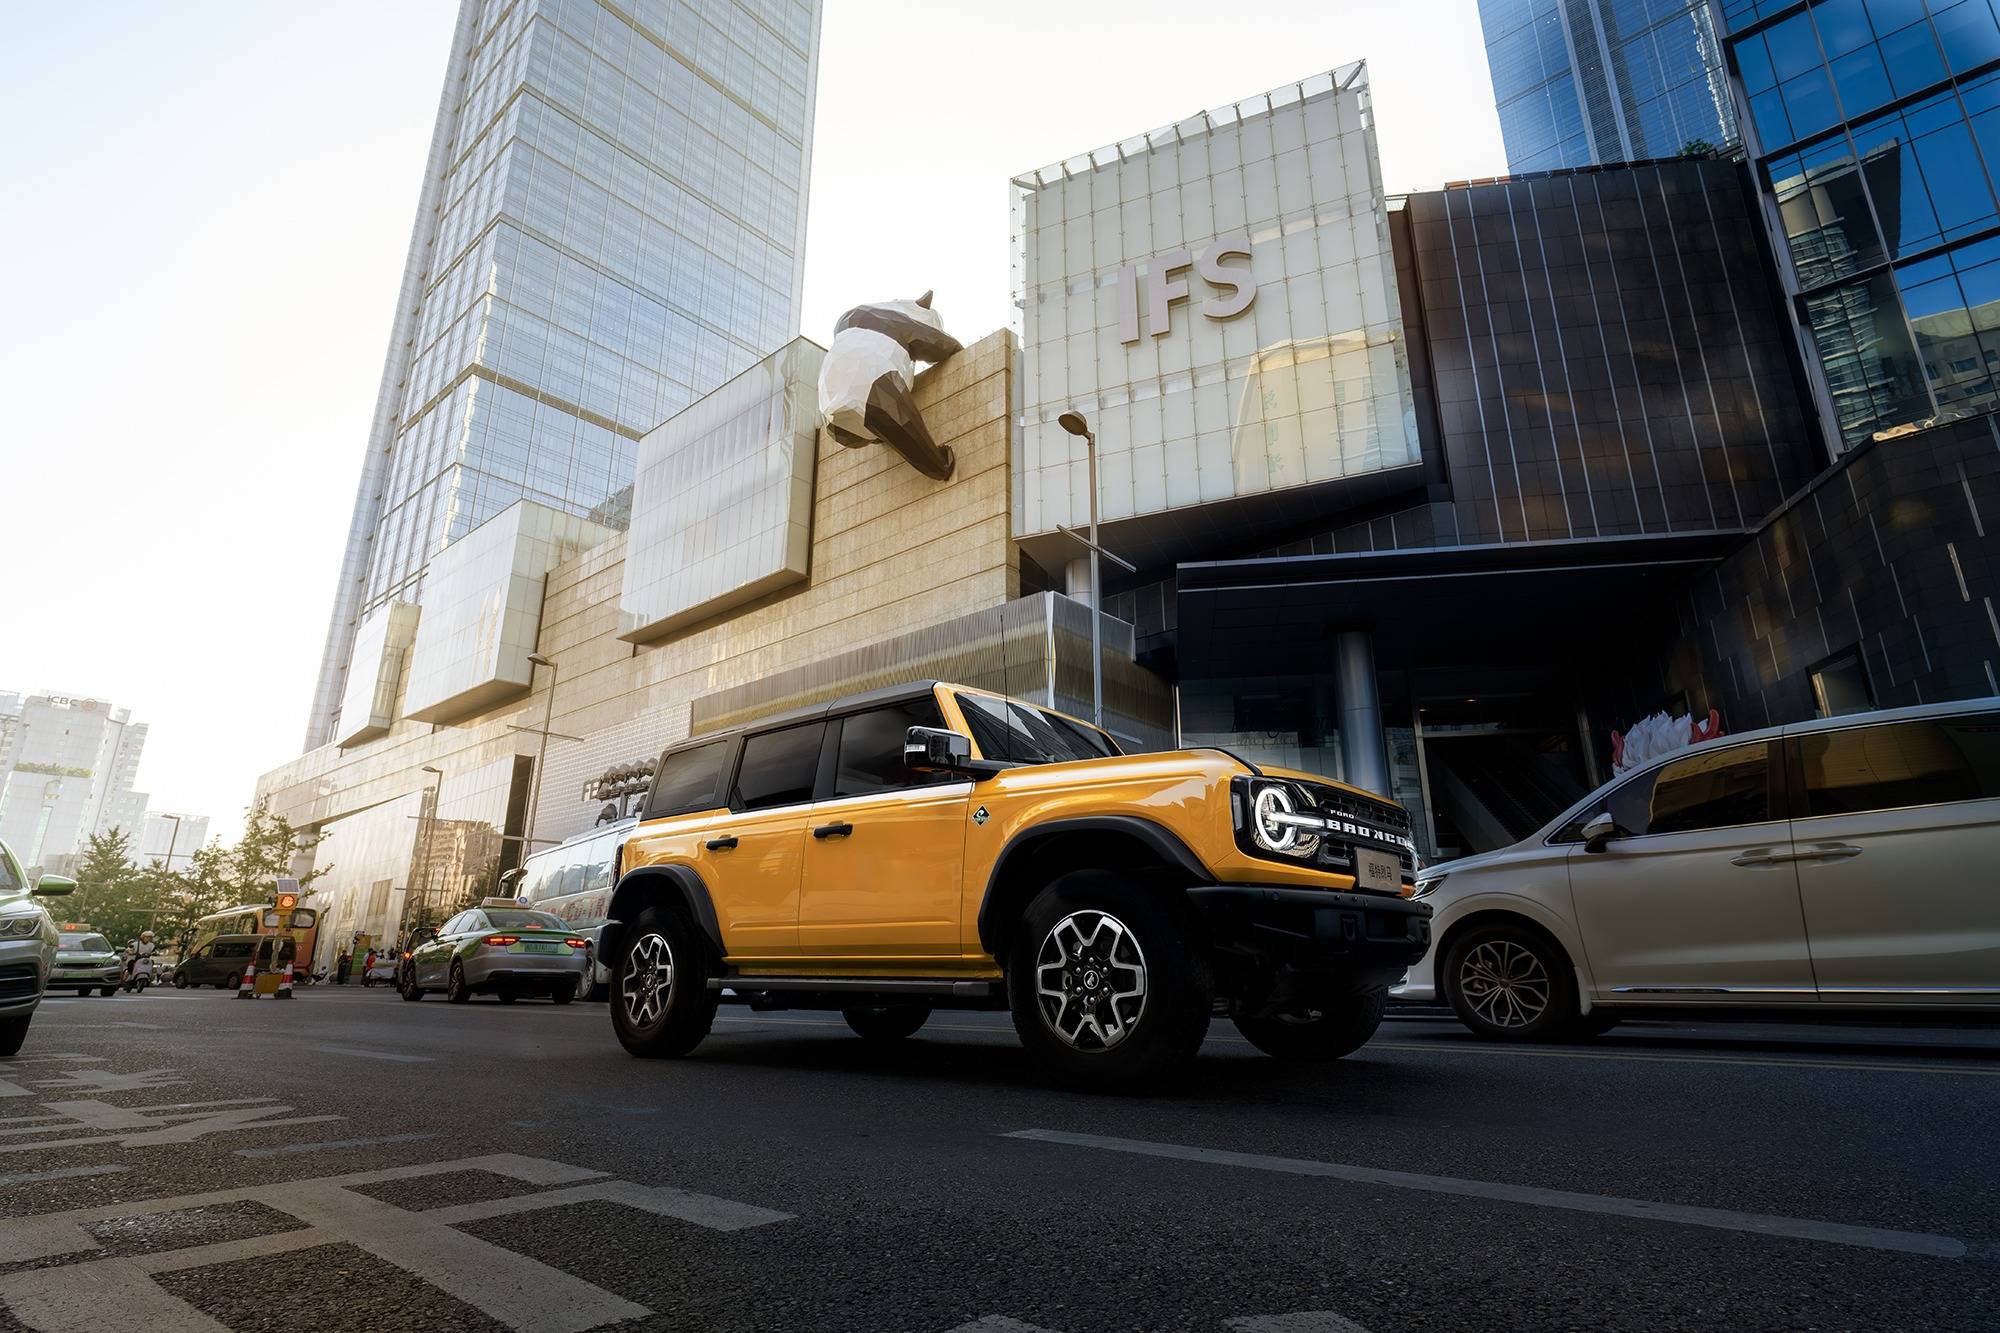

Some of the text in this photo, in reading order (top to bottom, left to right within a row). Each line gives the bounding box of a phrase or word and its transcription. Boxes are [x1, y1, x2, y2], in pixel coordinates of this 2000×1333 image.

[1118, 233, 1257, 345] IFS
[47, 694, 81, 707] ICBC
[1330, 809, 1355, 819] FORD
[1326, 818, 1408, 849] BRONCO
